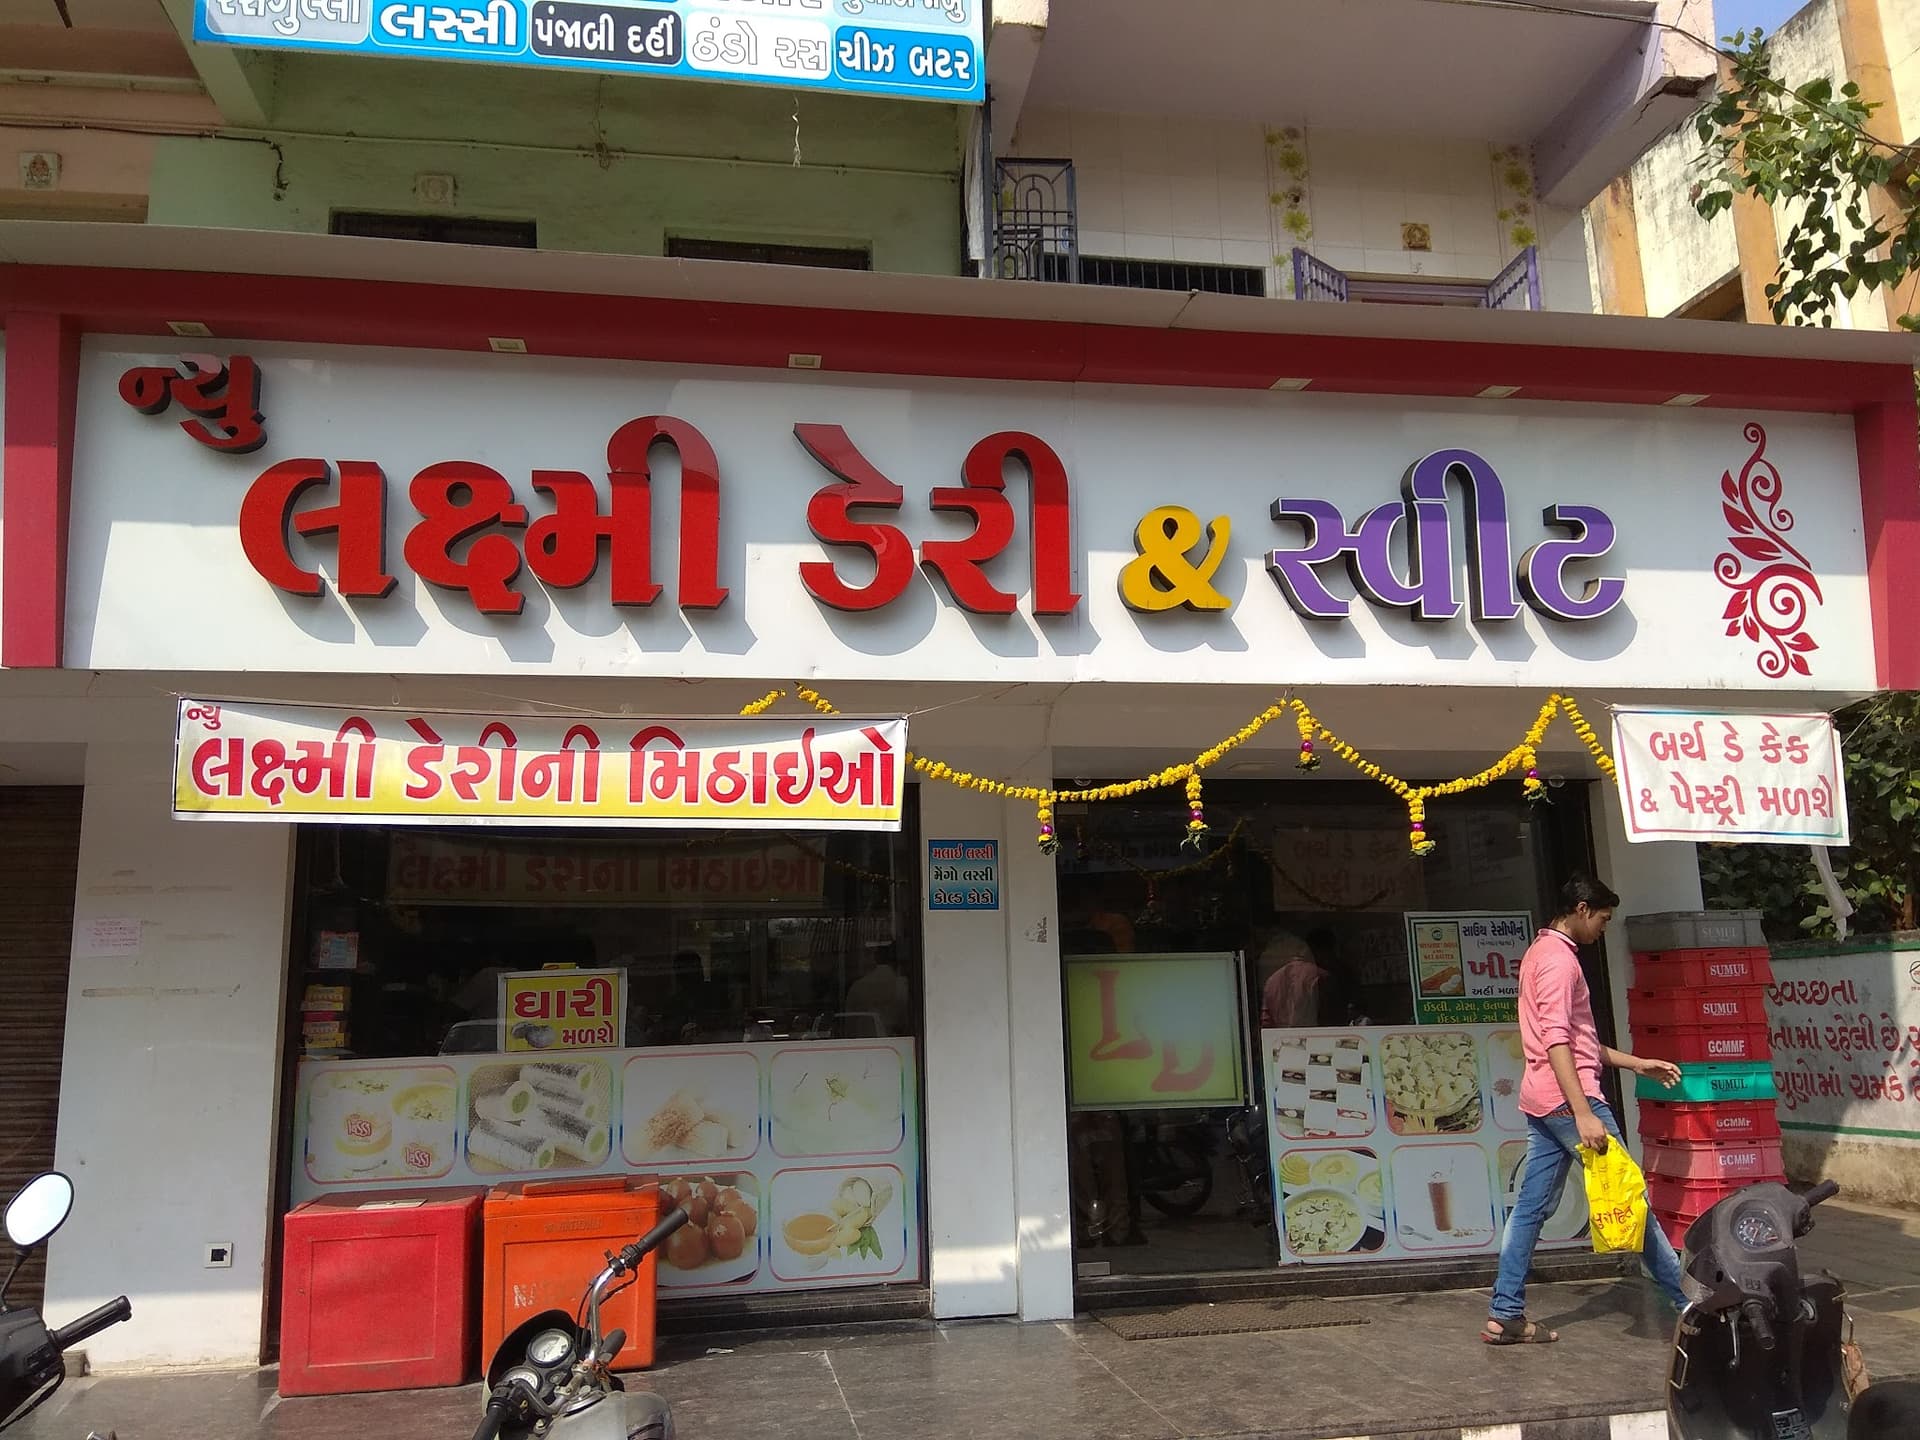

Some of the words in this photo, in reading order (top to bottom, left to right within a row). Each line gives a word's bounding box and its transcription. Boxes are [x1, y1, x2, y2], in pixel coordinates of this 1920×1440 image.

[379, 0, 517, 46] લસ્સી
[535, 6, 615, 52] પંજાબી
[627, 14, 674, 58] દહીં
[692, 16, 758, 66] ઠંડો
[774, 36, 828, 71] રસ
[838, 31, 895, 73] ચીઝ
[908, 46, 971, 80] બટર
[118, 354, 267, 453] ન્યુ
[239, 415, 729, 614] લક્ષ્મી
[793, 422, 1082, 616] ડેરી
[1117, 505, 1232, 613] &
[1264, 447, 1627, 622] સ્વીટ
[186, 704, 222, 730] ન્યુ
[191, 716, 377, 806] લક્ષ્મી
[405, 717, 600, 803] ડેરીની
[1649, 720, 1707, 761] બર્થ
[1720, 720, 1745, 763] ડે
[1759, 722, 1809, 764] કેક
[1640, 788, 1659, 812] &
[1670, 771, 1745, 826] પેસ્ટ્રી
[1758, 774, 1834, 818] મળશે
[1710, 963, 1748, 976] SUMUL
[1702, 1002, 1739, 1015] SUMUL
[562, 1021, 614, 1044] મળશે
[1708, 1040, 1745, 1053] GCMMF
[1711, 1079, 1748, 1091] SUMUL
[1719, 1153, 1757, 1166] GCMMF
